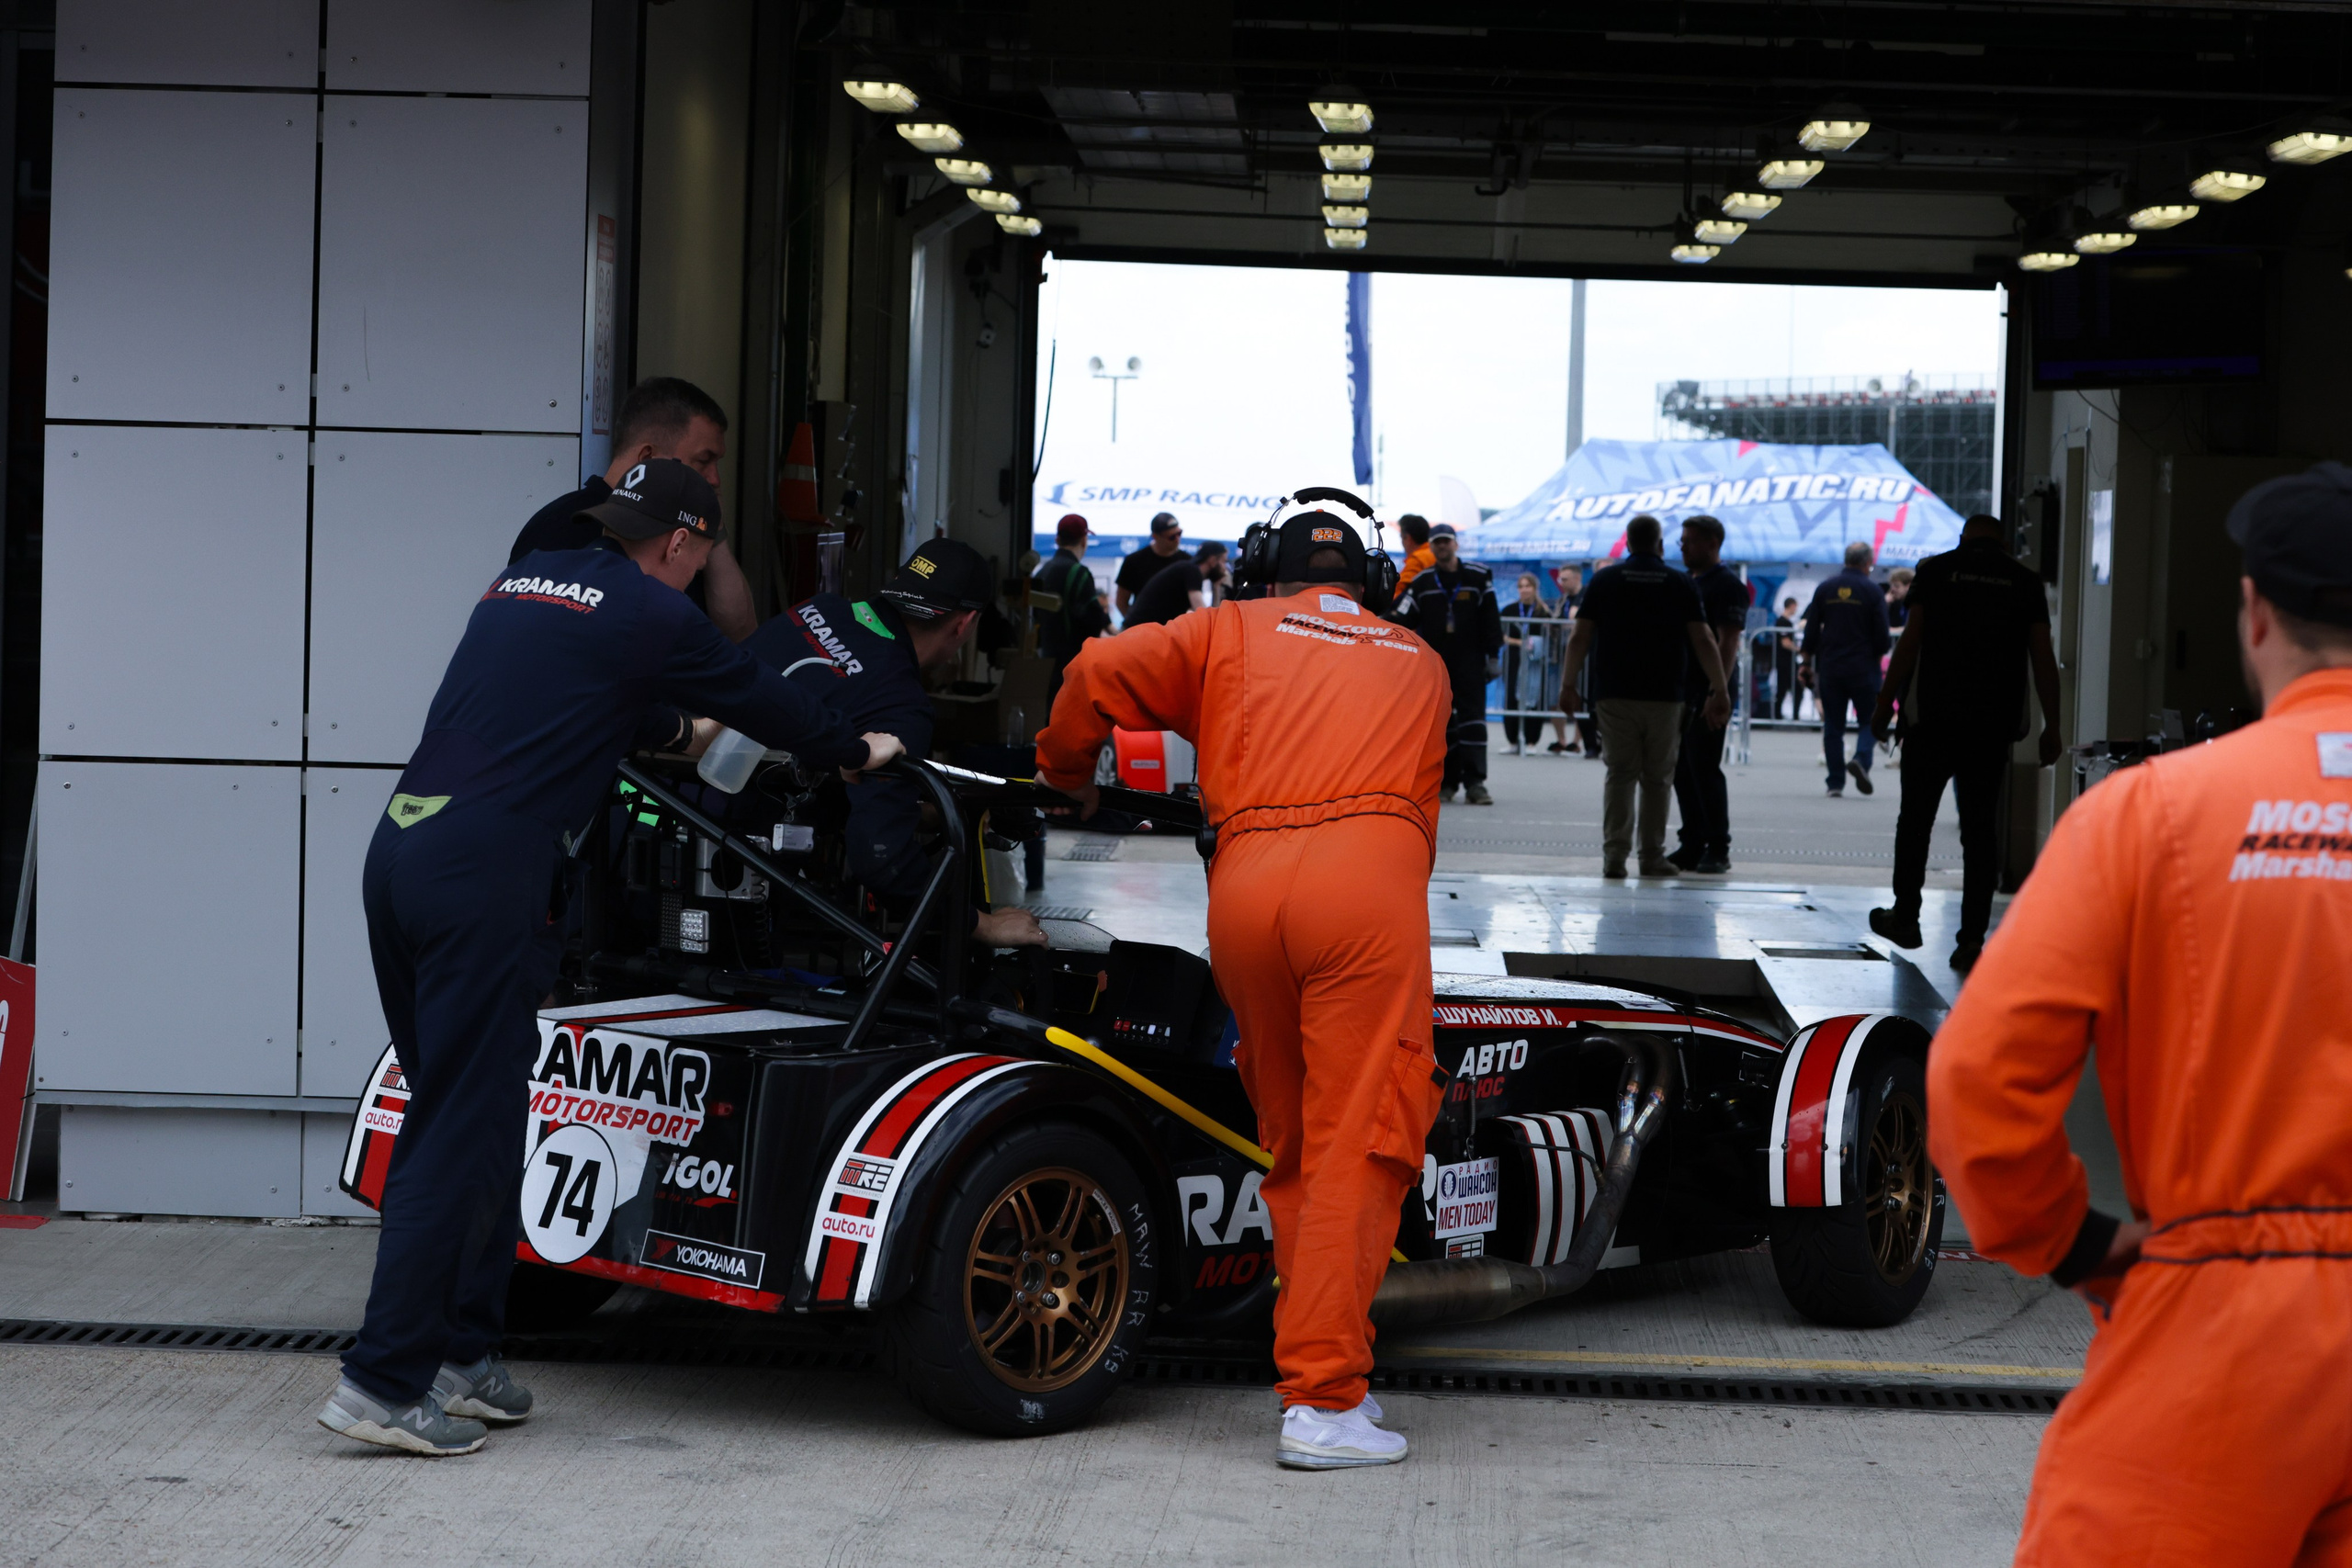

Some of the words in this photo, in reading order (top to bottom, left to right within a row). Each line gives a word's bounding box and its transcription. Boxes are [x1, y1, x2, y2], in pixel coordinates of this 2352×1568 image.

[1079, 487, 1152, 502] SMP
[1159, 489, 1283, 511] RACING
[1545, 475, 1915, 522] AUTOFANATIC.RU
[677, 510, 697, 526] ING
[1311, 527, 1343, 543] 222
[910, 558, 935, 575] OMP
[497, 576, 605, 608] KRAMAR
[514, 592, 595, 615] MOTORSPORT
[797, 604, 864, 677] KRAMAR
[1275, 623, 1358, 646] Marshals
[1372, 638, 1419, 654] Team
[1281, 617, 1357, 638] RACEWAY
[2245, 798, 2352, 834] MOS
[1438, 1004, 1542, 1026] ШУНАЙЛОВ
[531, 1032, 707, 1112] AMAR
[1456, 1039, 1529, 1079] АВТО
[528, 1089, 700, 1142] MOTORSPORT
[1459, 1159, 1498, 1176] РАДИО
[537, 1150, 602, 1238] 74
[1458, 1171, 1498, 1199] ШАНСОН
[822, 1216, 876, 1238] auto.ru
[1438, 1204, 1463, 1231] MEN
[1463, 1200, 1497, 1227] TODAY
[676, 1244, 747, 1278] YOKOHAMA
